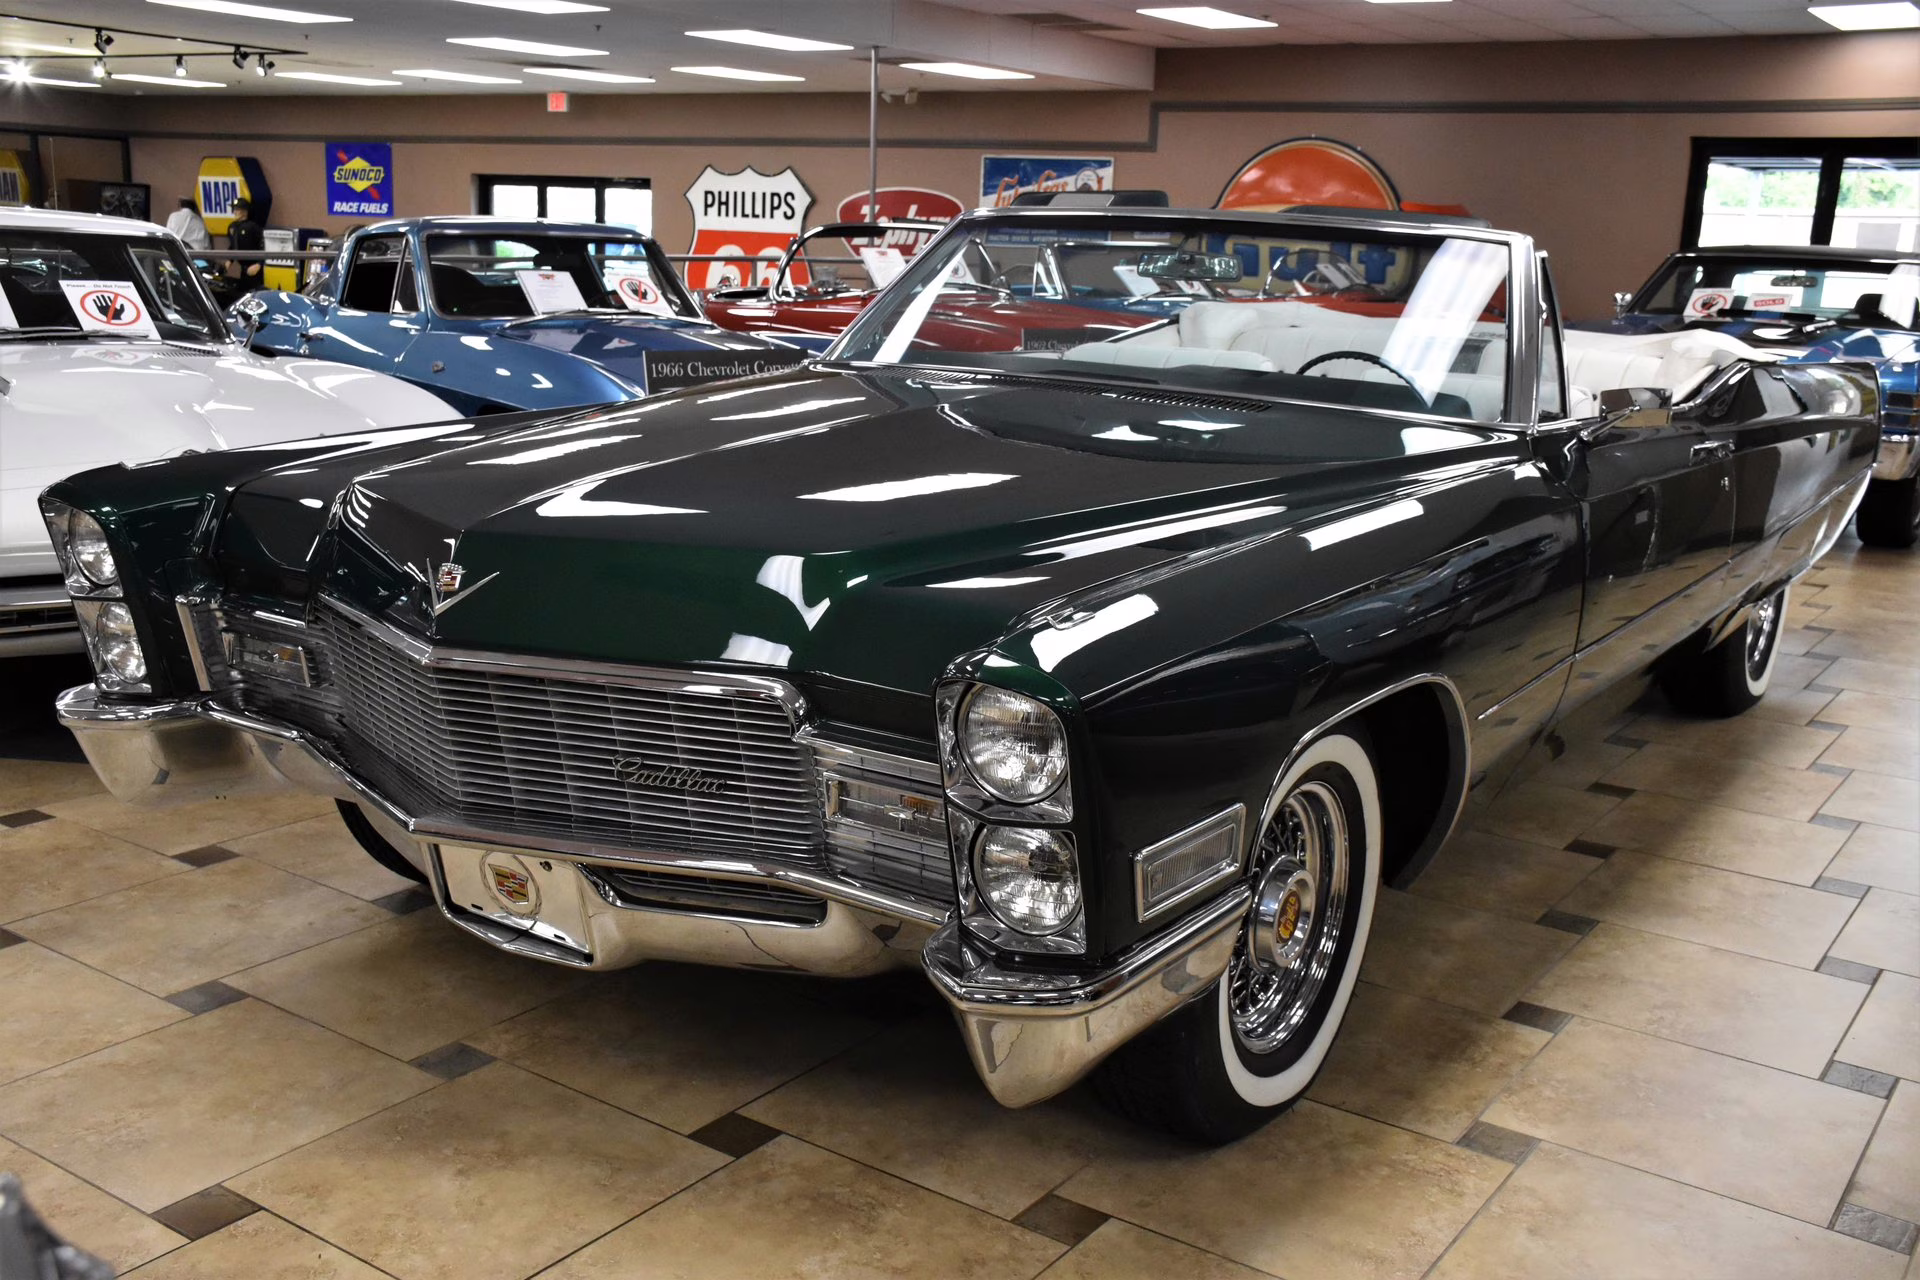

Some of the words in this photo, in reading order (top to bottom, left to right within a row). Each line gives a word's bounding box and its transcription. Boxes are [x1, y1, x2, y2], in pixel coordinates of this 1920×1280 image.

[336, 168, 382, 181] SUNOCO
[202, 181, 238, 214] NAPA
[333, 201, 359, 213] RACE
[360, 202, 389, 214] FUELS
[704, 190, 795, 220] PHILLIPS
[652, 362, 684, 378] 1966
[687, 361, 750, 377] Chevrolet
[754, 360, 803, 375] Corvett
[612, 754, 726, 793] Cadillac
